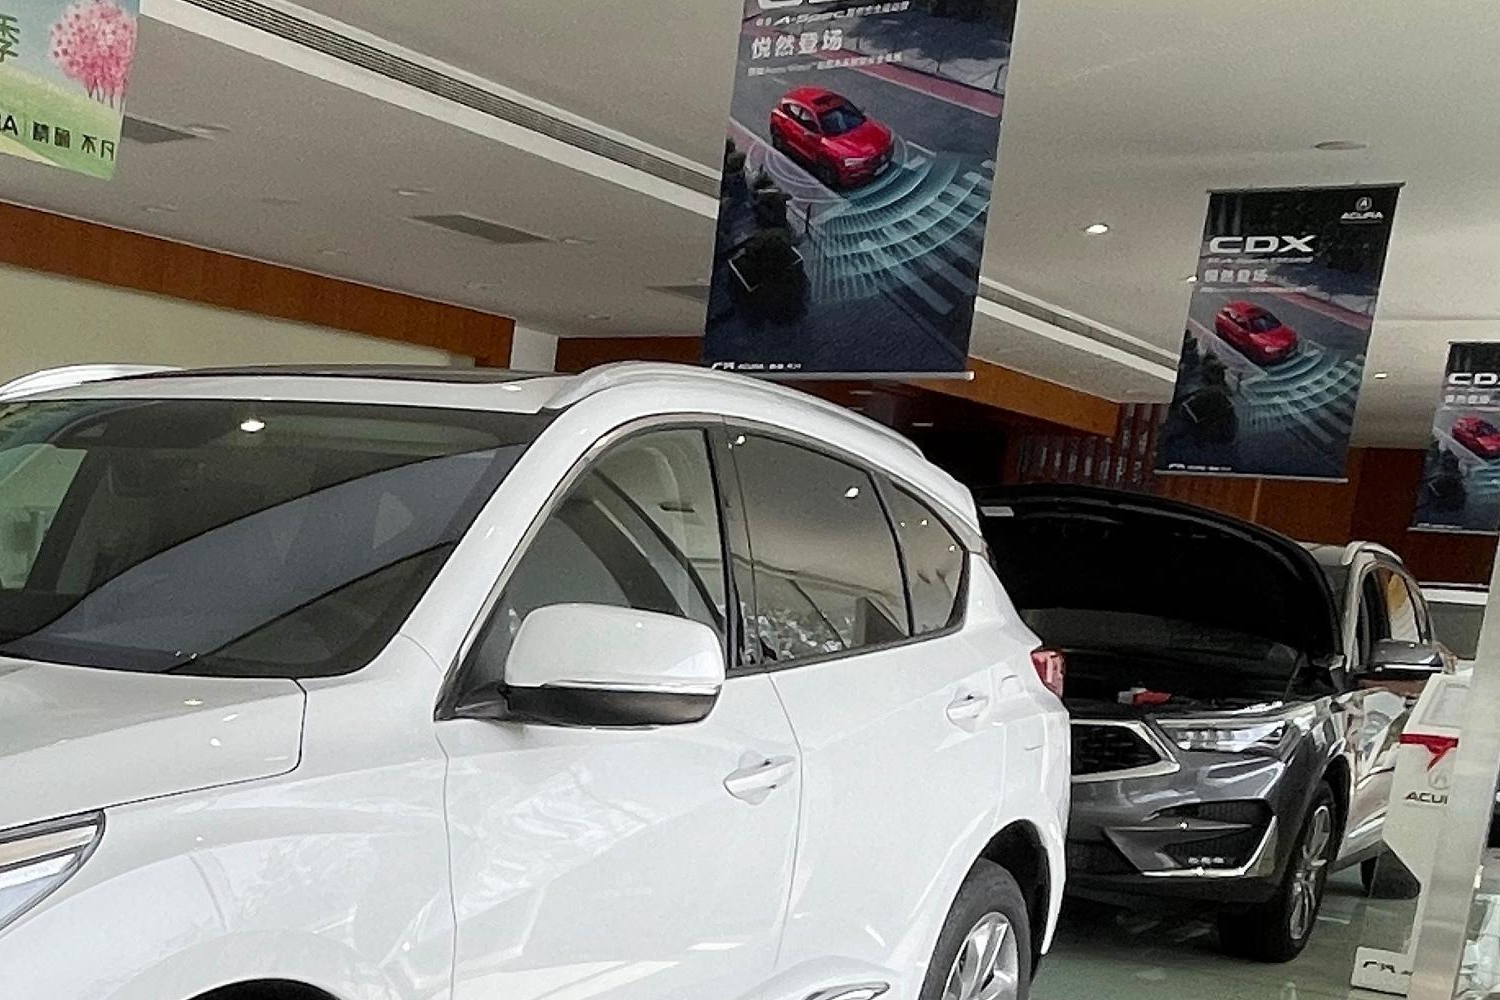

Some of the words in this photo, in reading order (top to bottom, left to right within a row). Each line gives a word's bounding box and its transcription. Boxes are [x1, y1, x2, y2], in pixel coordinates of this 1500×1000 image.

[1340, 210, 1384, 221] ACURA
[1209, 234, 1317, 254] CDX
[1448, 372, 1500, 385] CD
[1405, 790, 1449, 805] ACU
